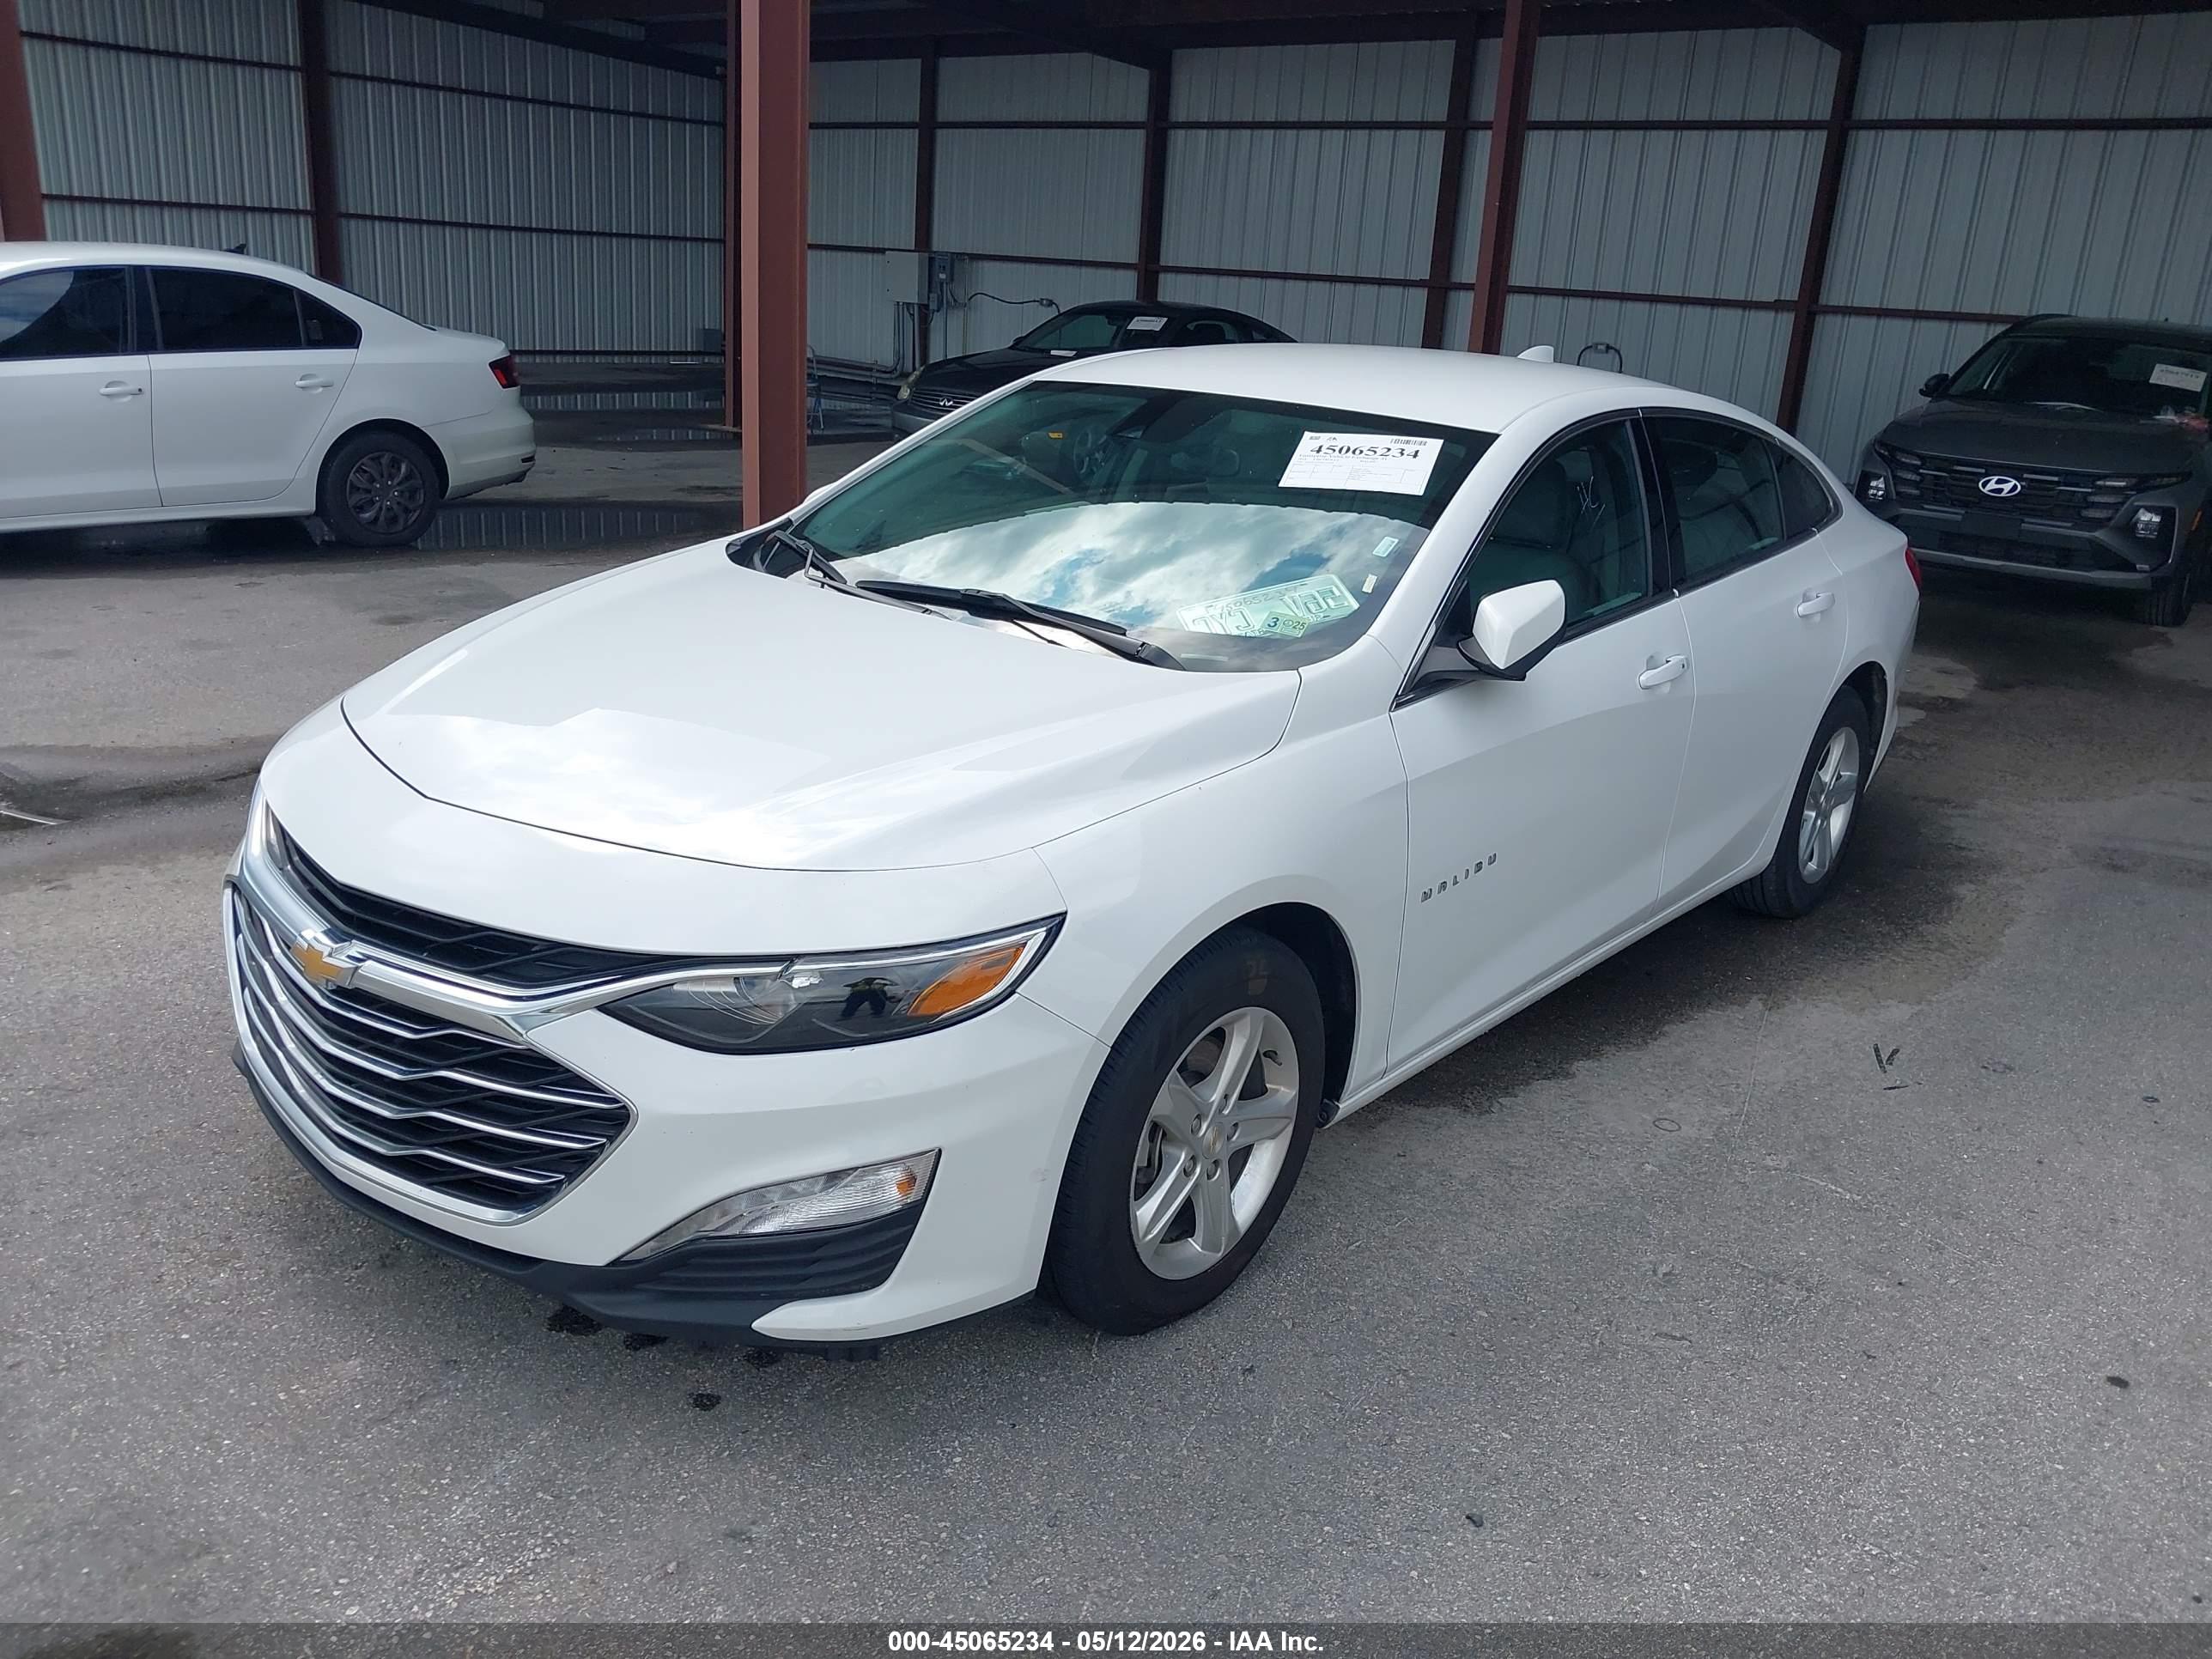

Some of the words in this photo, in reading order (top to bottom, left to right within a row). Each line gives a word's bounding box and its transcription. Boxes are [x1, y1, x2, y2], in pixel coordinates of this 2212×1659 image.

[1310, 444, 1421, 459] 45065234
[1267, 617, 1279, 628] 3
[1292, 621, 1307, 631] 25
[1420, 852, 1497, 903] MALIBU
